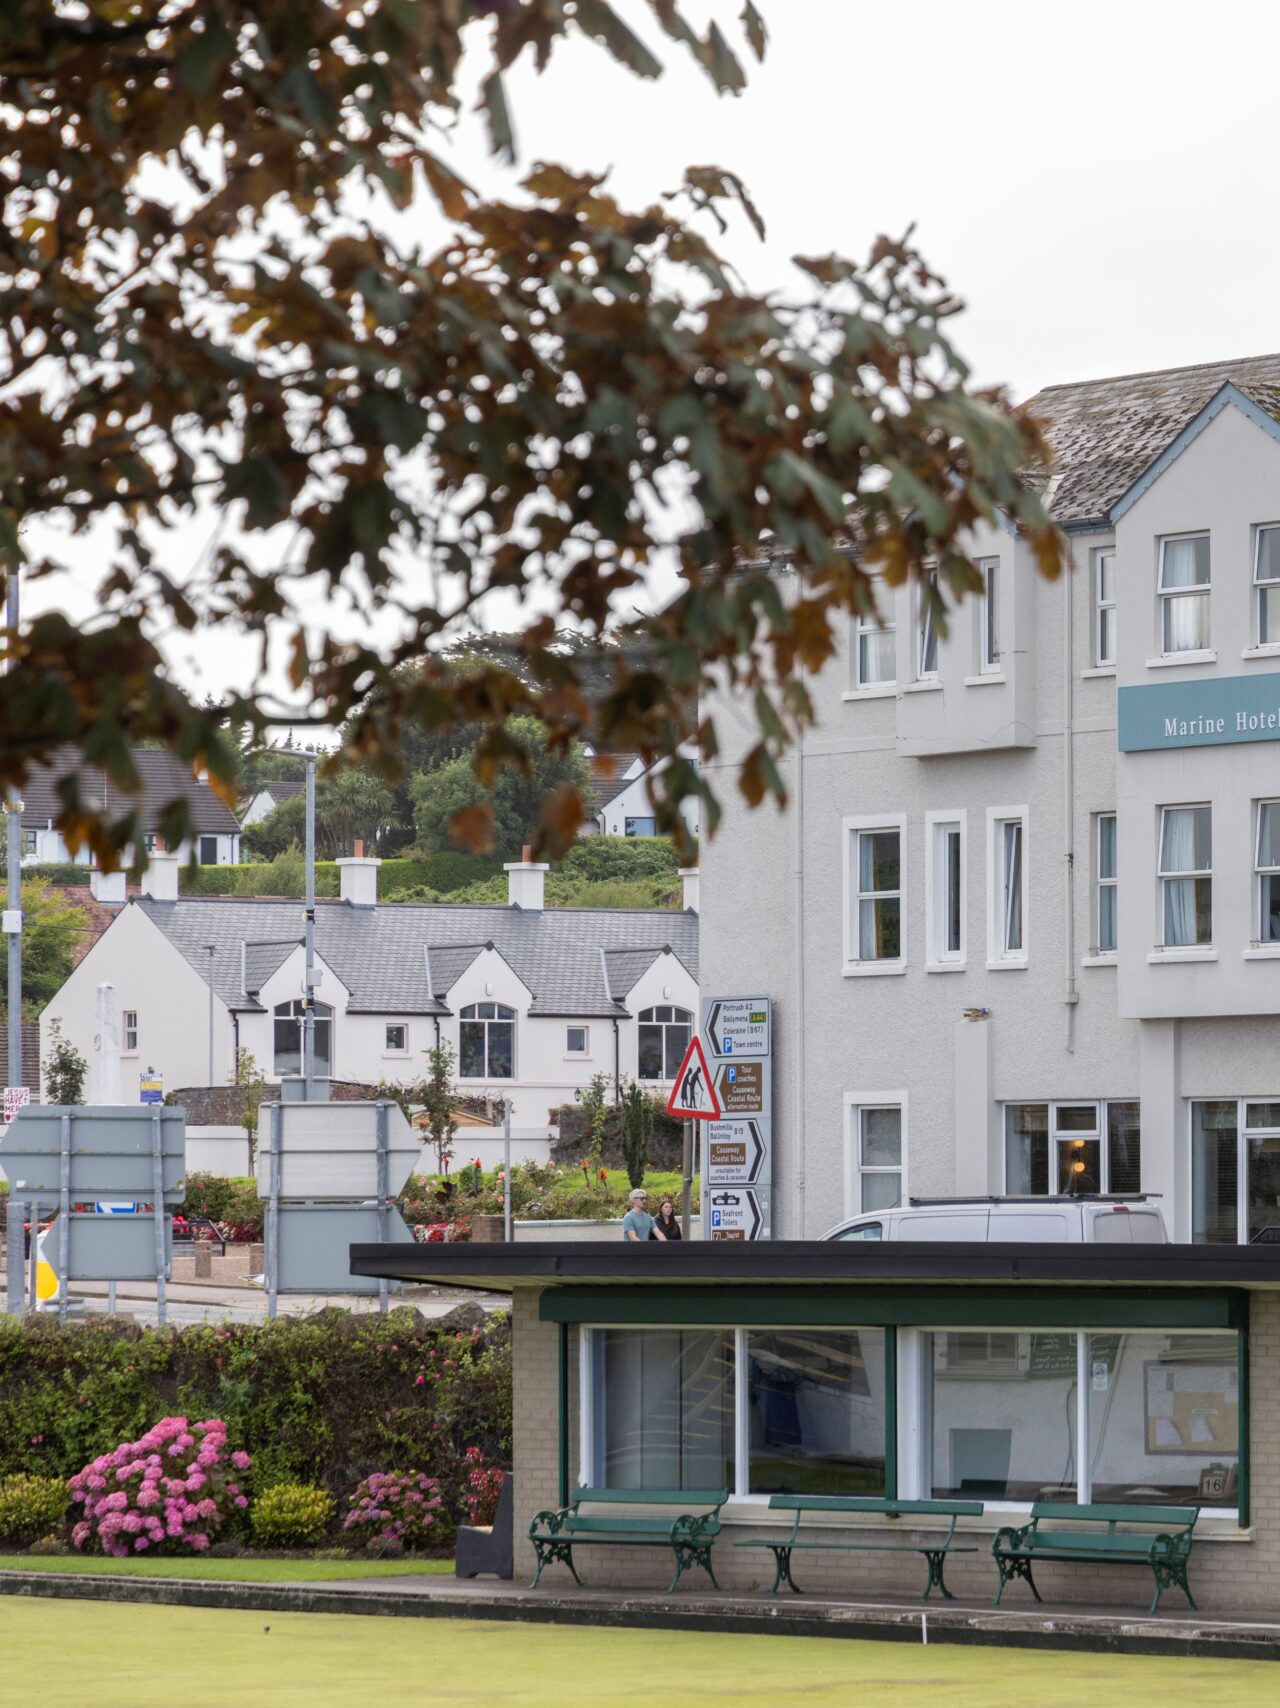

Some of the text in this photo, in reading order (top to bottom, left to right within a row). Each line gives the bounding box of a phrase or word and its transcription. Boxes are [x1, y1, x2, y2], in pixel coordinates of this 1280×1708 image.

[1164, 715, 1225, 737] Marine
[723, 1004, 744, 1012] Portrush
[723, 1015, 748, 1023] Ballymena
[723, 1025, 764, 1035] Coleraine (B67)
[741, 1065, 752, 1073] Tour
[5, 1089, 28, 1097] JESUS
[732, 1086, 756, 1094] Causeway
[746, 1094, 761, 1102] Route
[710, 1123, 733, 1131] Bushmills
[734, 1127, 744, 1135] B15
[710, 1132, 731, 1140] Ballintoy
[716, 1145, 740, 1154] Causeway
[730, 1154, 745, 1162] Route
[722, 1209, 744, 1217] Seafront
[722, 1218, 738, 1226] Toilets
[1205, 1479, 1221, 1492] 16
